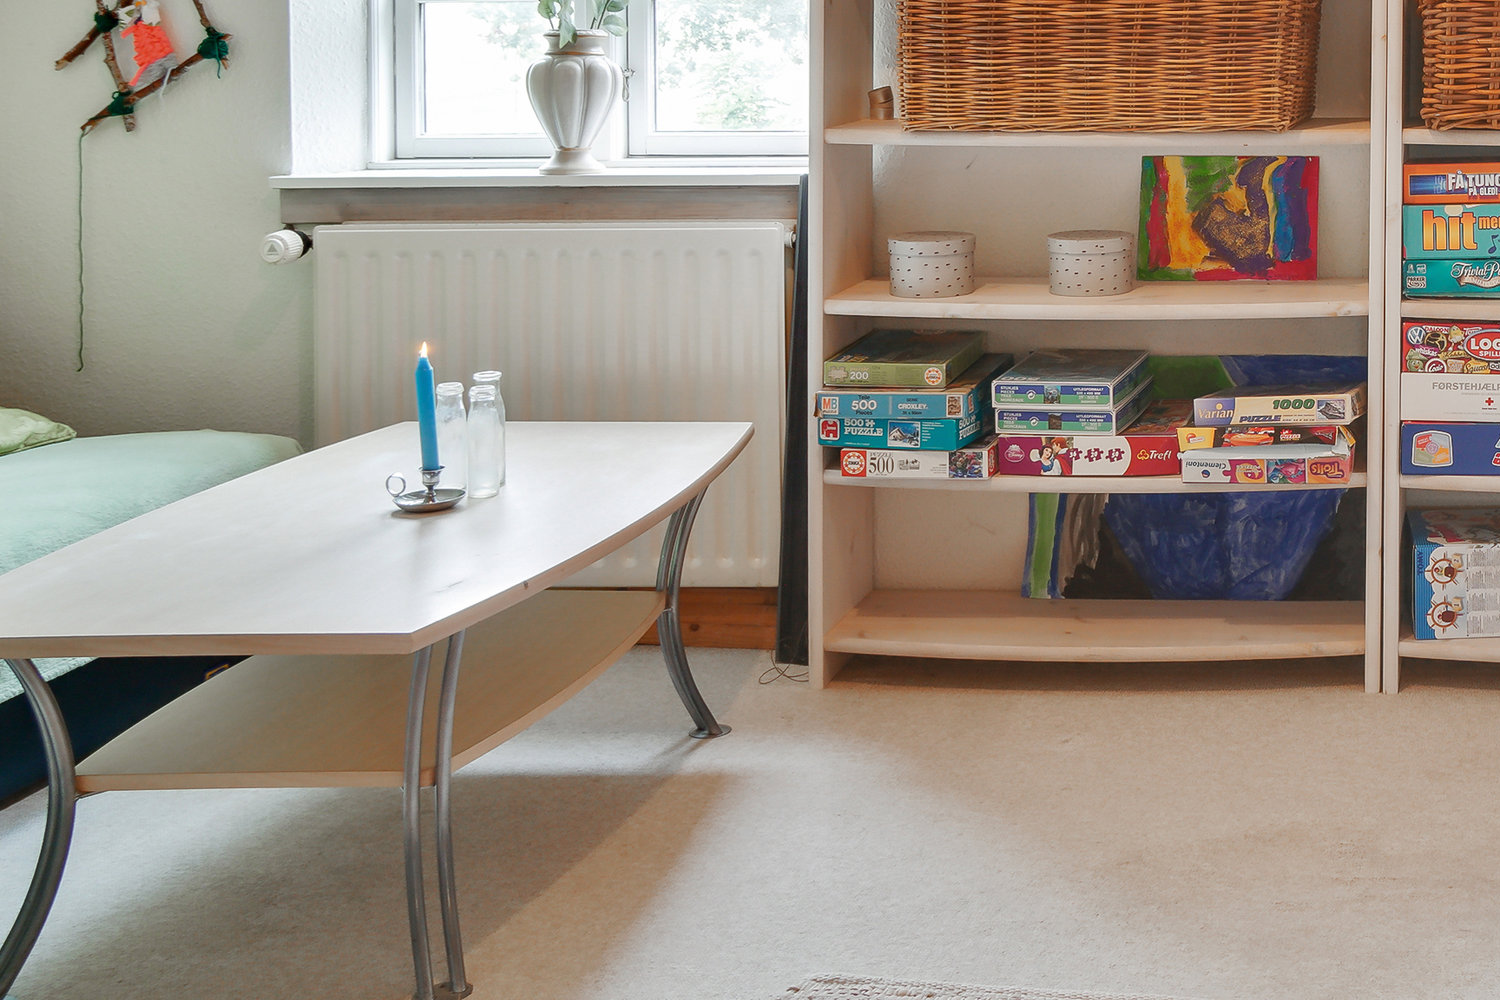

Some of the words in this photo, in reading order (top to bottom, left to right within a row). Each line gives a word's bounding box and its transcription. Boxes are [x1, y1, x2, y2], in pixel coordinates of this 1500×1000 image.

[1448, 170, 1465, 191] FÅ
[1422, 210, 1477, 251] hit
[850, 371, 869, 380] 200
[851, 400, 878, 411] 500
[1273, 399, 1315, 410] 1000
[1199, 408, 1234, 419] Varian
[1239, 415, 1282, 424] PUZZLE
[844, 427, 884, 437] PUZZLE
[1149, 449, 1172, 461] Trefl
[868, 456, 895, 474] 500
[1185, 461, 1227, 469] Clementoni
[1310, 462, 1344, 479] Trolls
